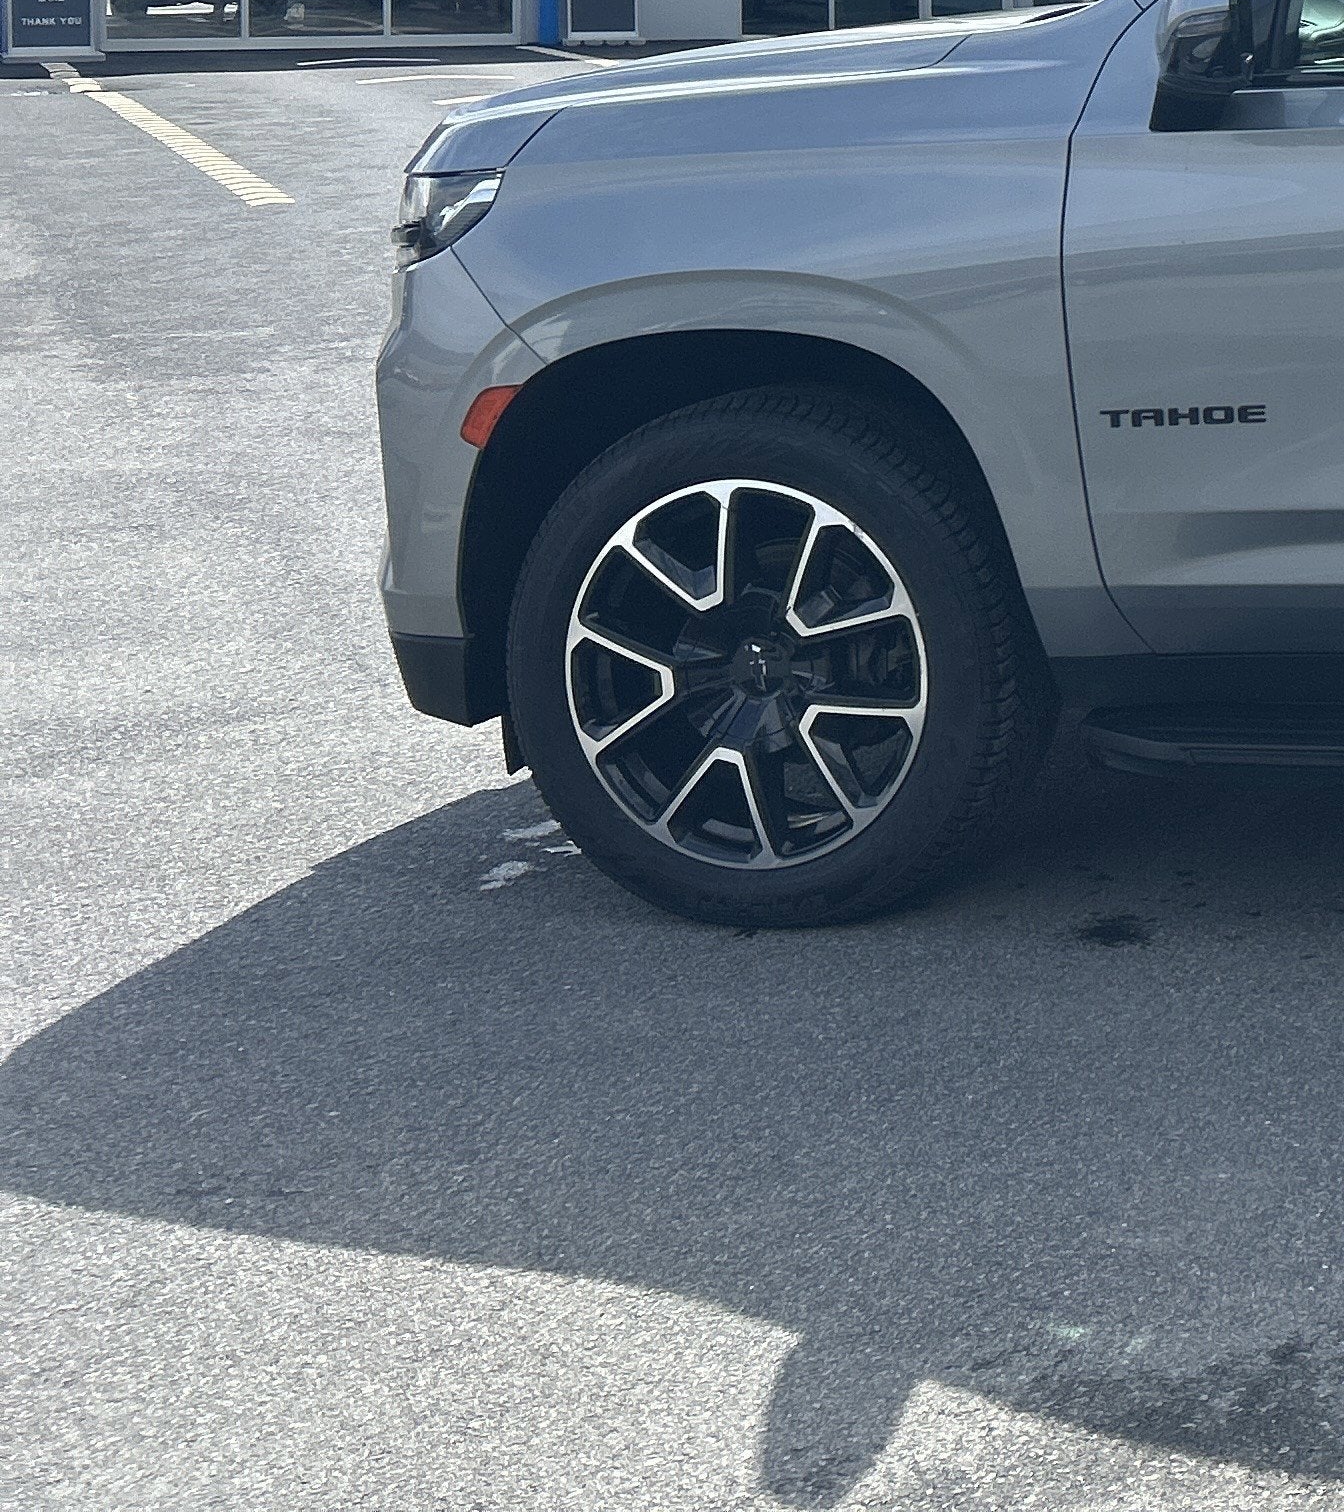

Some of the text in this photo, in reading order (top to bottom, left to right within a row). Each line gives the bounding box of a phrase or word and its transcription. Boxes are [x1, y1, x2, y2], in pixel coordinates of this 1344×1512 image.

[21, 17, 82, 26] THANK YOU
[1100, 404, 1267, 429] TAHOE
